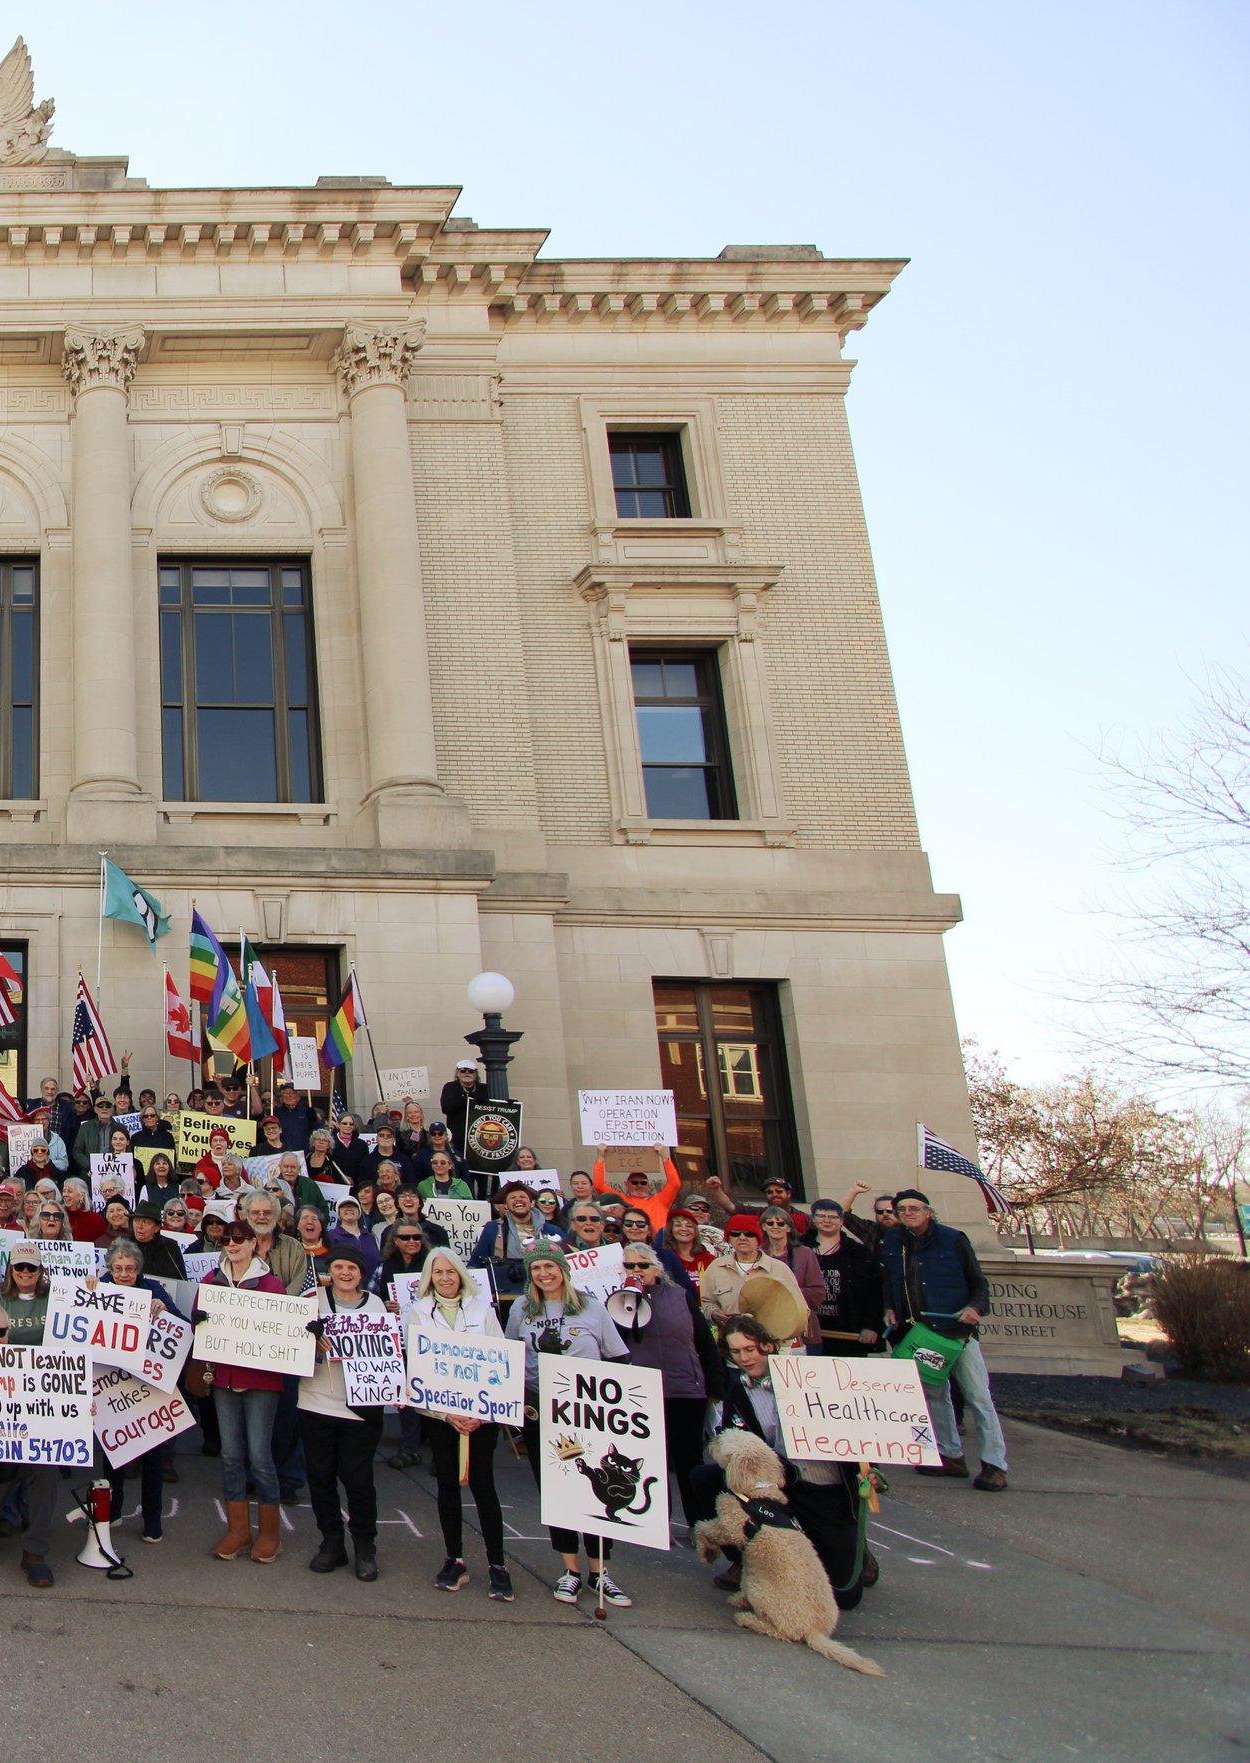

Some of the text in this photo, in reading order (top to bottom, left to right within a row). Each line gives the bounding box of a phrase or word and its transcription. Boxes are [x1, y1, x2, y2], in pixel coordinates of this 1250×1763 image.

[292, 1043, 315, 1051] TRUMP
[296, 1071, 317, 1079] PUPPET
[383, 1069, 424, 1081] UNITED
[583, 1096, 610, 1105] WHY
[615, 1096, 643, 1105] IRAN
[474, 1114, 514, 1131] ONLY YOU CAN
[599, 1109, 658, 1119] OPERATION
[606, 1120, 656, 1130] EPSTEIN
[593, 1131, 665, 1141] DISTRACTION
[182, 1147, 199, 1157] Not
[491, 1138, 516, 1158] FASCISM
[98, 1164, 127, 1174] WANT
[620, 1158, 643, 1167] ICE
[428, 1204, 480, 1222] Are You
[464, 1224, 474, 1239] of
[75, 1253, 91, 1265] 2.0
[566, 1250, 598, 1271] TOP
[53, 1286, 146, 1314] RIP SAVE RIP
[205, 1289, 227, 1304] OUR
[52, 1312, 140, 1352] USAID
[206, 1312, 226, 1327] FOR
[230, 1316, 248, 1330] YOU
[253, 1320, 283, 1336] WERE
[287, 1325, 310, 1339] LOW
[1004, 1324, 1056, 1338] STREET
[205, 1335, 265, 1357] BUT HOLY
[329, 1333, 403, 1358] NO KING!
[31, 1349, 86, 1381] leaving
[347, 1360, 402, 1373] NO WAR
[417, 1334, 510, 1379] Democracy
[356, 1374, 391, 1384] FOR A
[434, 1358, 503, 1385] is not a
[772, 1357, 821, 1389] We
[833, 1358, 915, 1394] Deserve
[23, 1374, 36, 1392] is
[41, 1373, 87, 1395] GONE
[350, 1385, 401, 1403] KING!
[576, 1373, 622, 1404] NO
[107, 1384, 150, 1413] takes
[410, 1377, 521, 1422] Spectator Sport
[786, 1392, 928, 1424] a Healthcare
[6, 1404, 21, 1421] up
[26, 1398, 54, 1417] with
[62, 1404, 78, 1418] us
[552, 1399, 650, 1439] KINGS
[102, 1399, 184, 1451] Courage
[29, 1438, 90, 1464] 54703
[792, 1426, 923, 1465] Hearing
